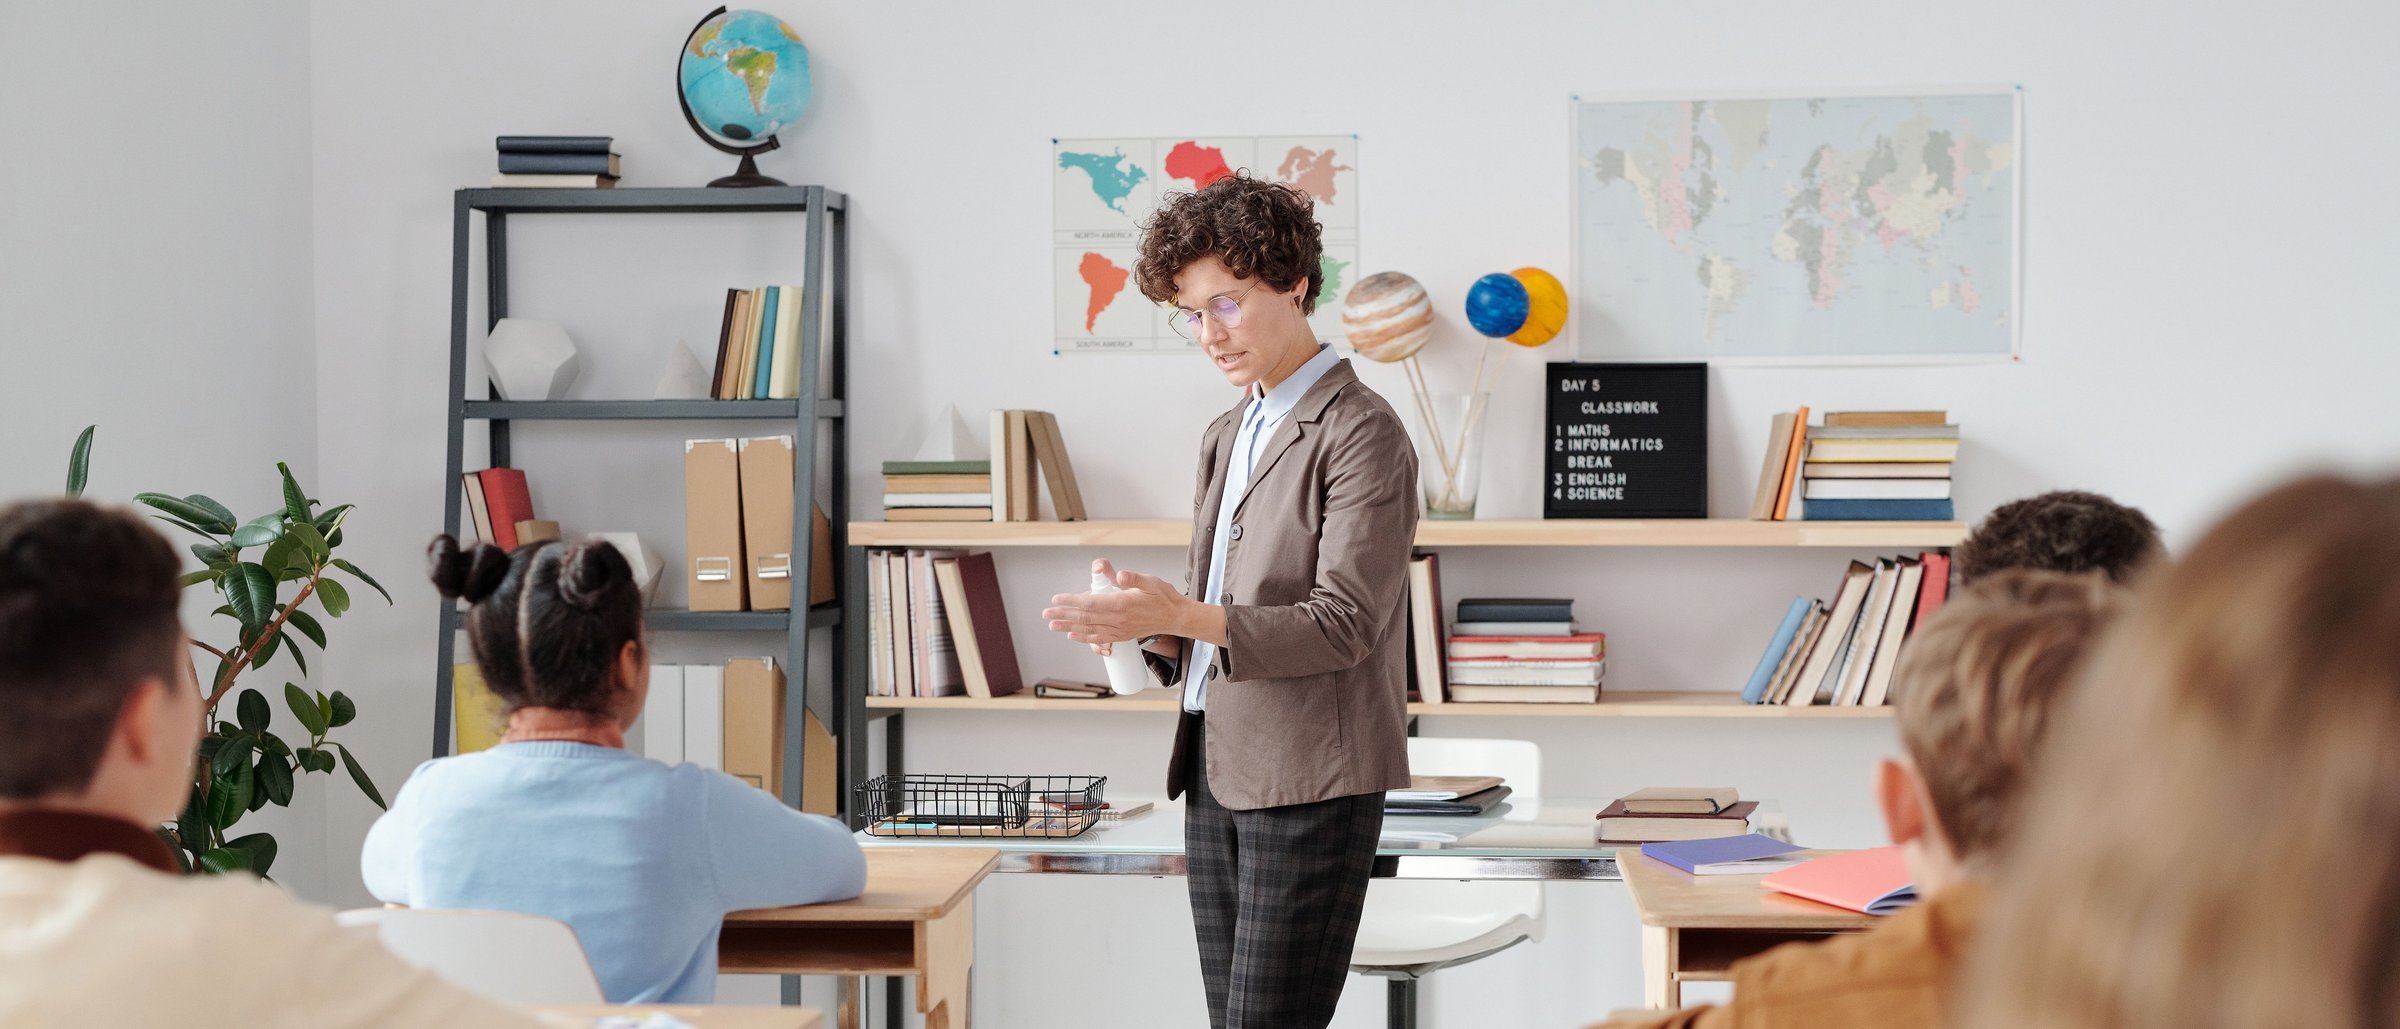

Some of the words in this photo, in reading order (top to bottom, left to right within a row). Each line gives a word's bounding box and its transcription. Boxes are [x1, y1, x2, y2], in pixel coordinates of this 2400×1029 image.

[1074, 231, 1100, 239] NORTH
[1101, 231, 1133, 239] AMERICA
[1076, 340, 1101, 348] SOUTH
[1102, 340, 1134, 348] AMERICA
[1561, 379, 1587, 392] DAY
[1592, 379, 1601, 392] 5
[1581, 401, 1659, 414] CLASSWORK
[1555, 424, 1562, 437] 1
[1567, 424, 1611, 437] MATHS
[1554, 438, 1563, 452] 2
[1568, 438, 1664, 451] INFORMATICS
[1567, 456, 1613, 469] BREAK
[1554, 473, 1563, 486] 3
[1568, 473, 1627, 486] ENGLISH
[1553, 487, 1563, 500] 4
[1567, 487, 1624, 500] SCIENCE
